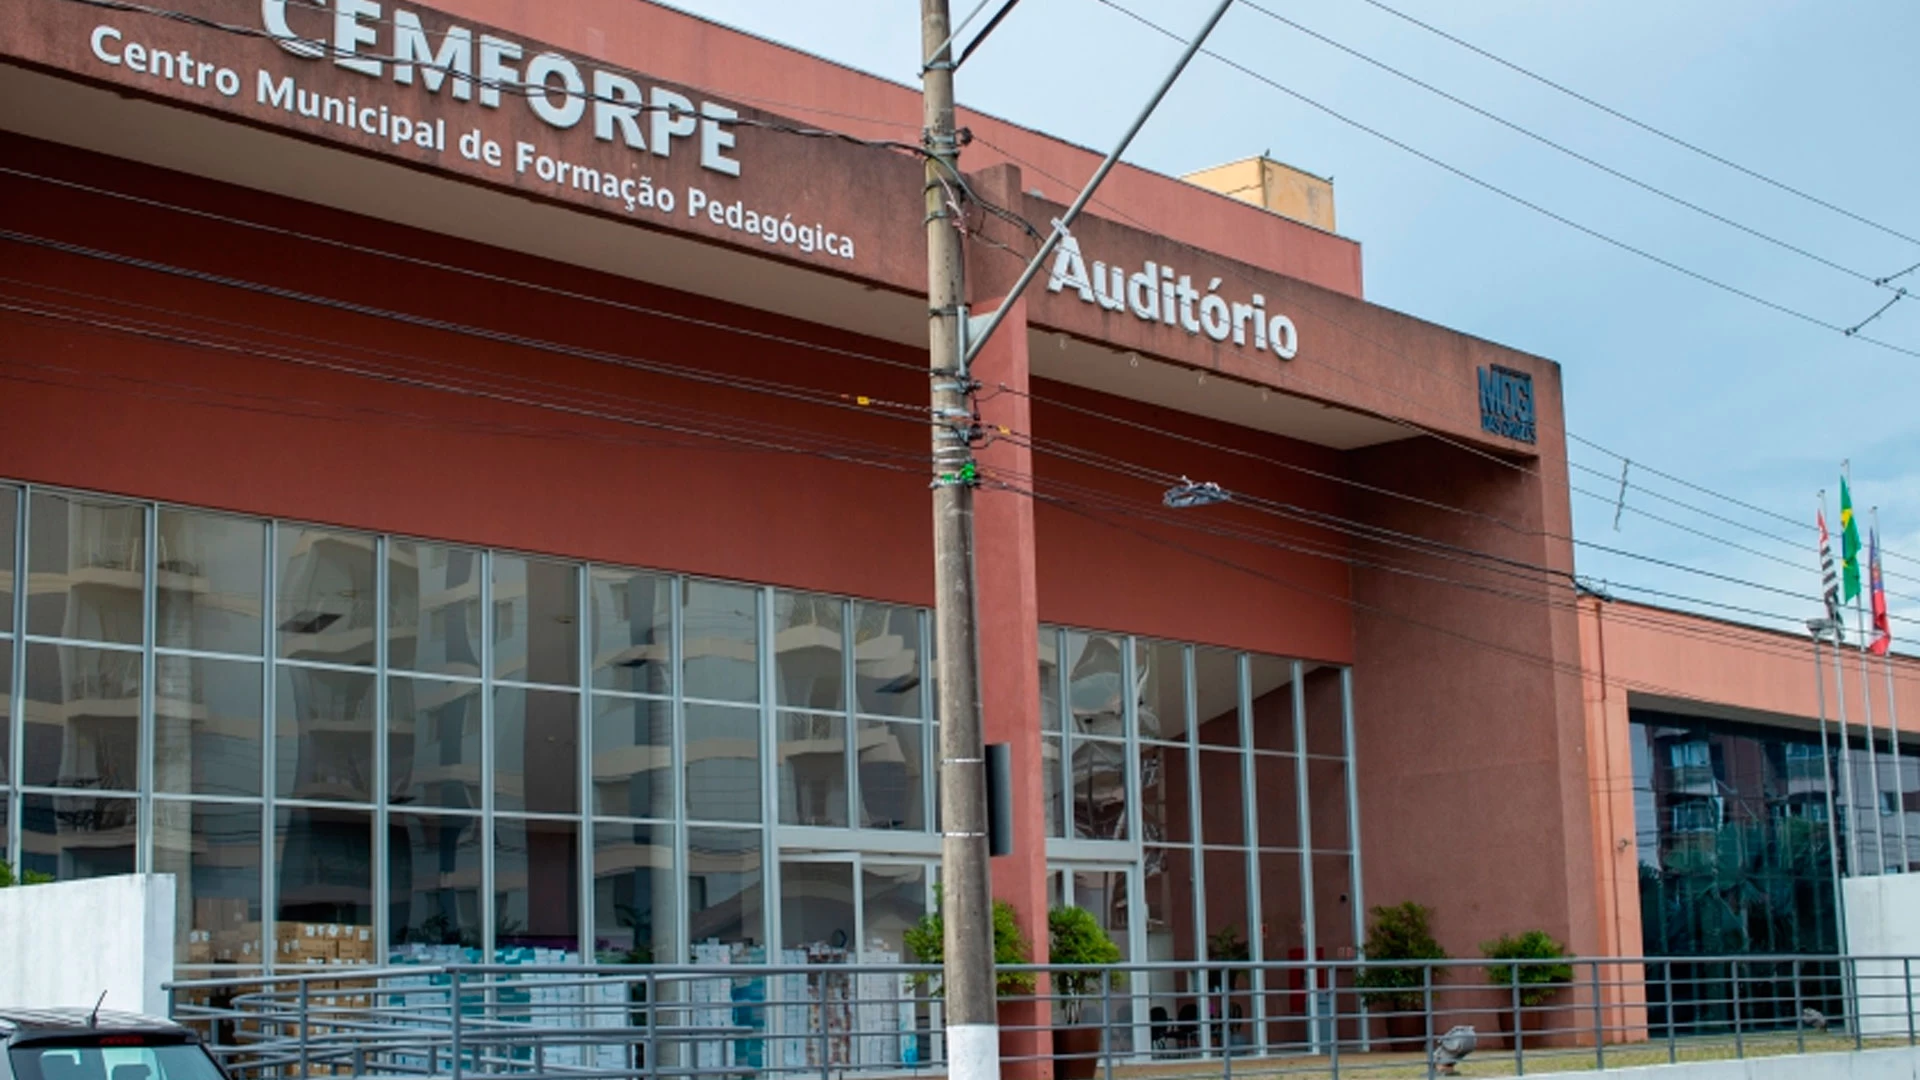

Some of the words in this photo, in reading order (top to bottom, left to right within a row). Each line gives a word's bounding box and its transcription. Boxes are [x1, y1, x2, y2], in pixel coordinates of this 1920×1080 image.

[90, 25, 241, 97] Centro
[256, 69, 445, 152] Municipal
[459, 128, 502, 168] de
[515, 141, 675, 212] Formação
[688, 187, 855, 260] Pedagógica
[262, 0, 741, 177] CEMFORPE
[1046, 234, 1299, 361] Auditório
[1477, 366, 1535, 423] MOGI
